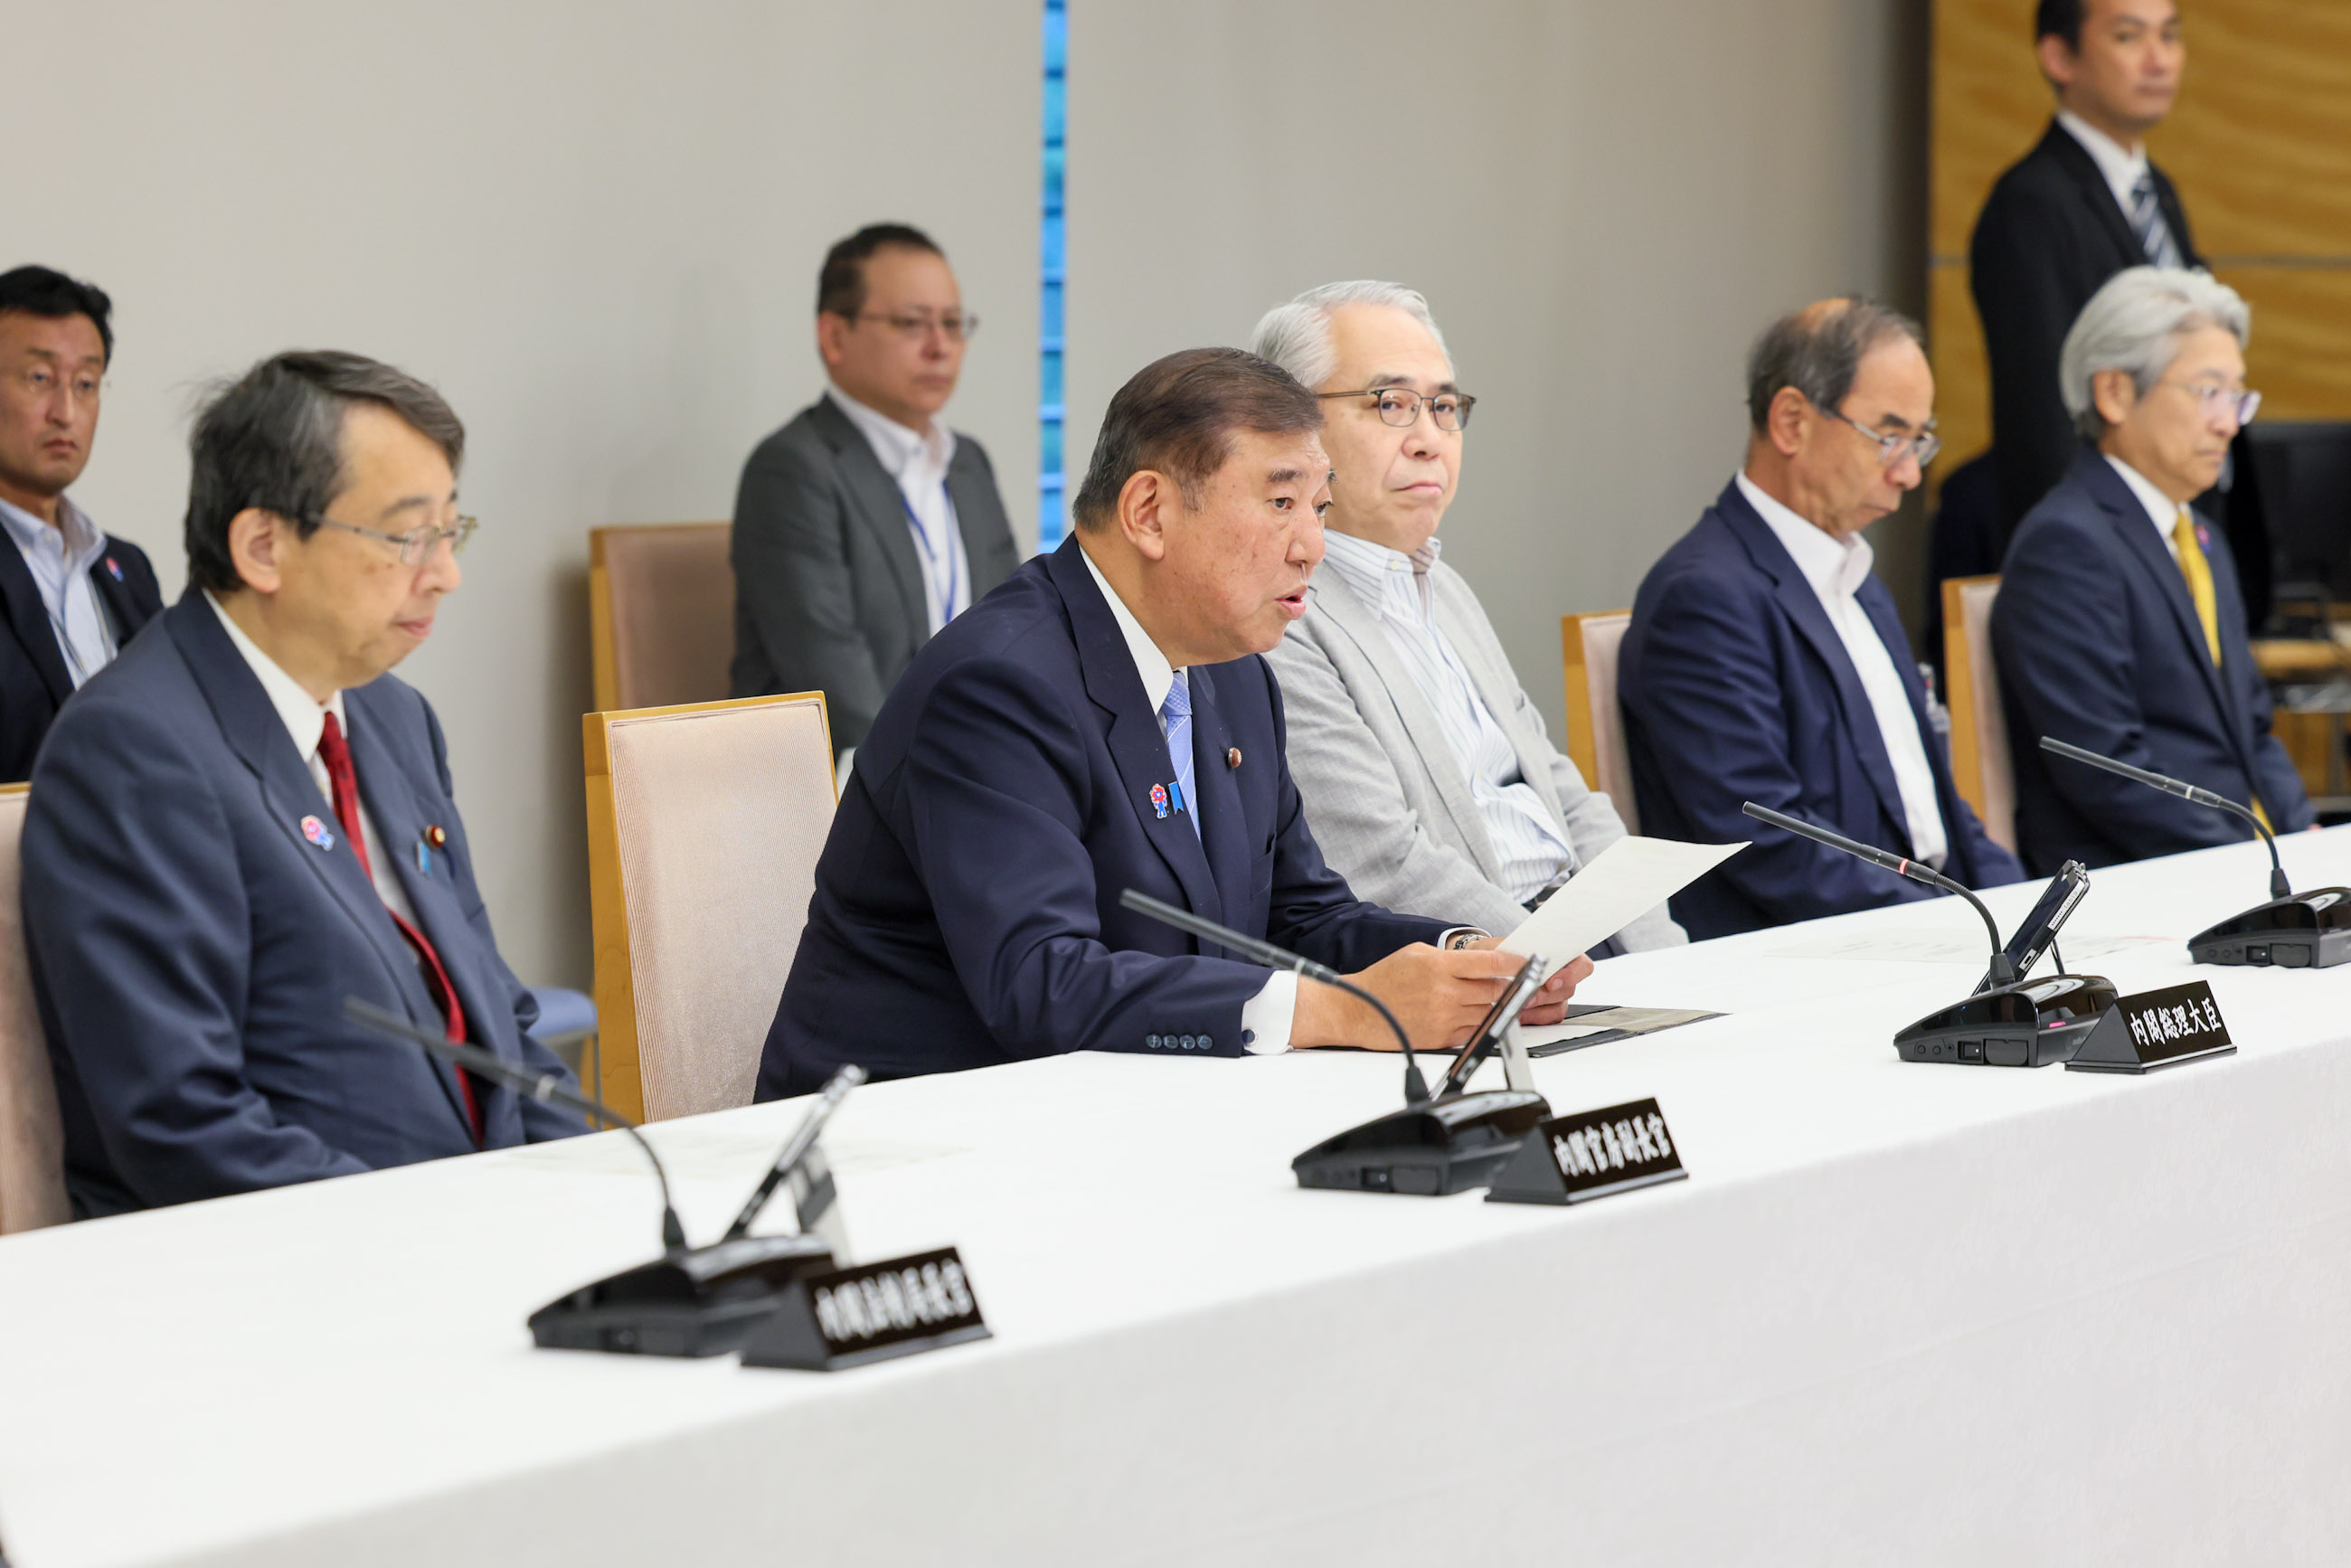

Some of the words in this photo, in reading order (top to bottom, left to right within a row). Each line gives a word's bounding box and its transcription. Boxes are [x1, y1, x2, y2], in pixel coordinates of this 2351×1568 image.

[2129, 997, 2222, 1046] 内閣総理大臣
